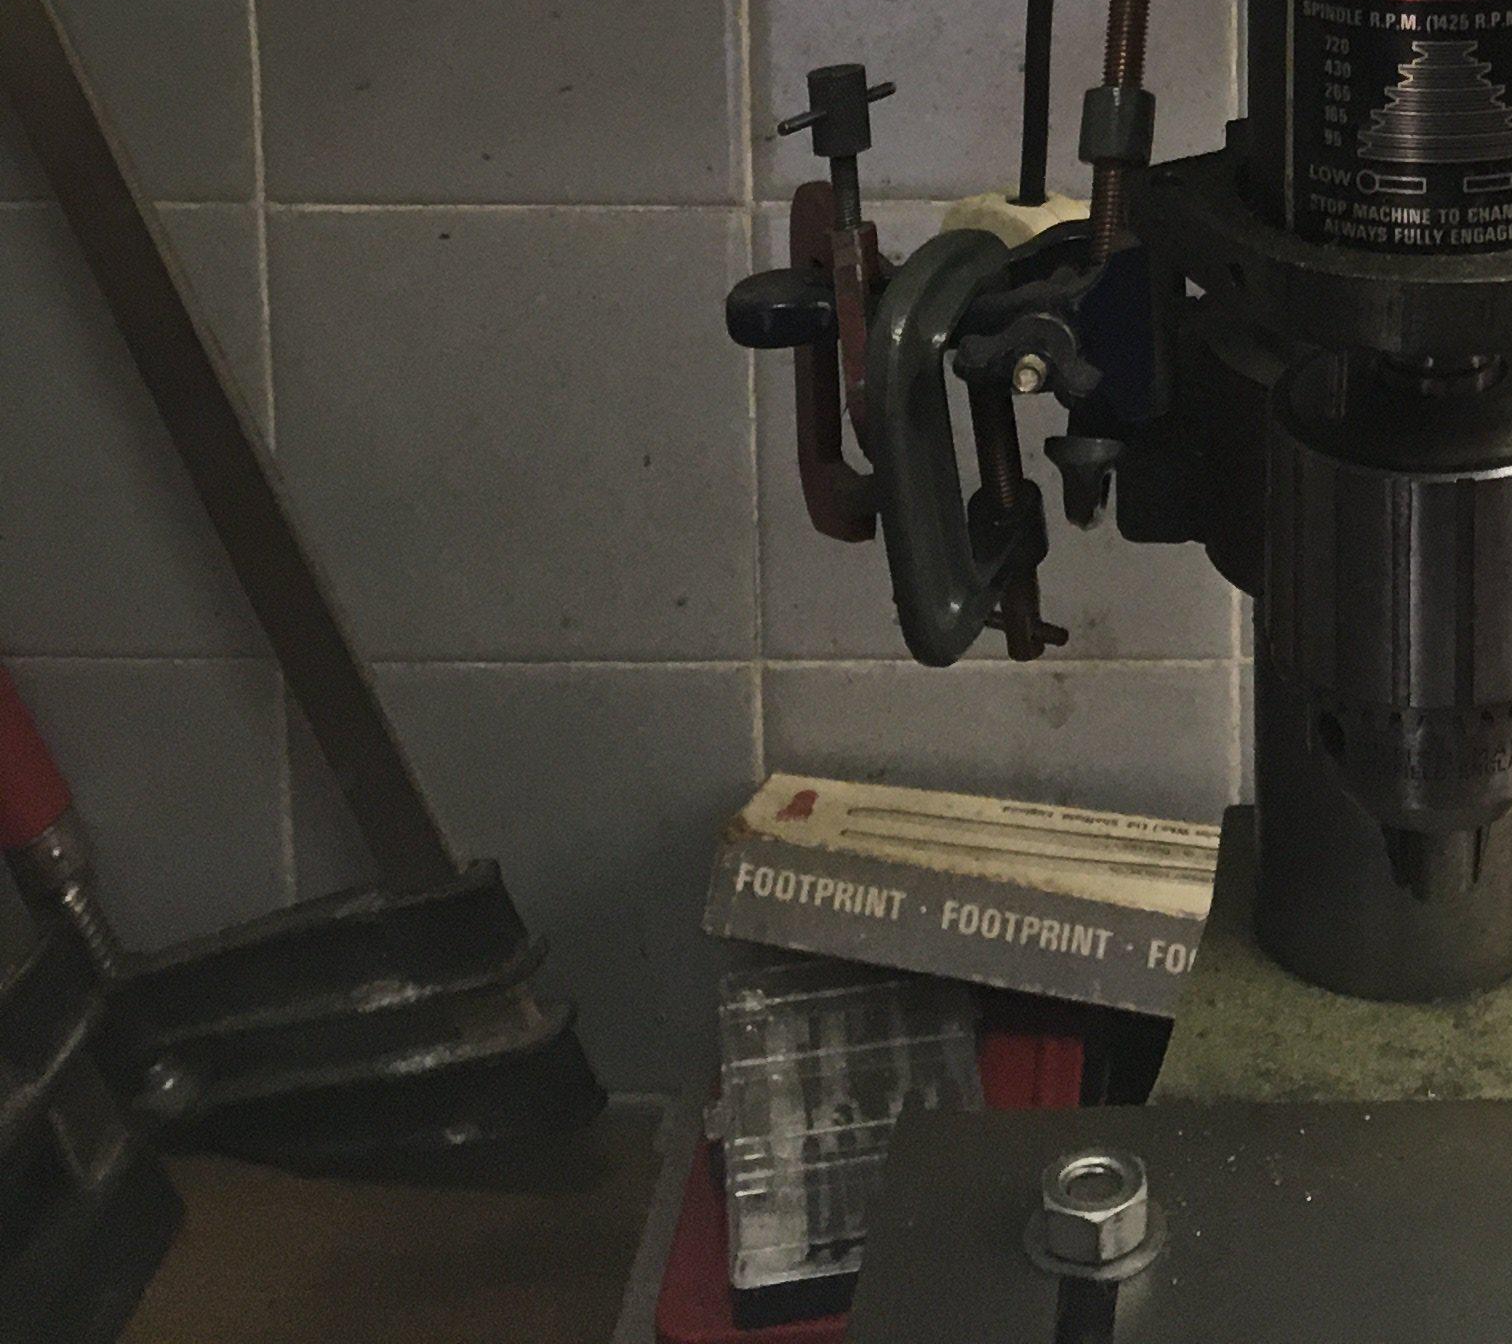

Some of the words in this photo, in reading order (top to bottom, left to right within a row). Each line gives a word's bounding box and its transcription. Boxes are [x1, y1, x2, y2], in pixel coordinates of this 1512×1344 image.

[1303, 0, 1362, 26] SPINDLE
[1369, 12, 1421, 31] R.P.M.
[1309, 164, 1351, 186] LOW
[1309, 193, 1347, 213] STOP
[1353, 203, 1431, 225] MACHINE
[1440, 208, 1460, 224] TO
[1323, 217, 1388, 242] ALWAYS
[1394, 227, 1443, 245] FULLY
[735, 861, 907, 920] FOOTPRINT
[941, 900, 1114, 960] FOOTPRINT
